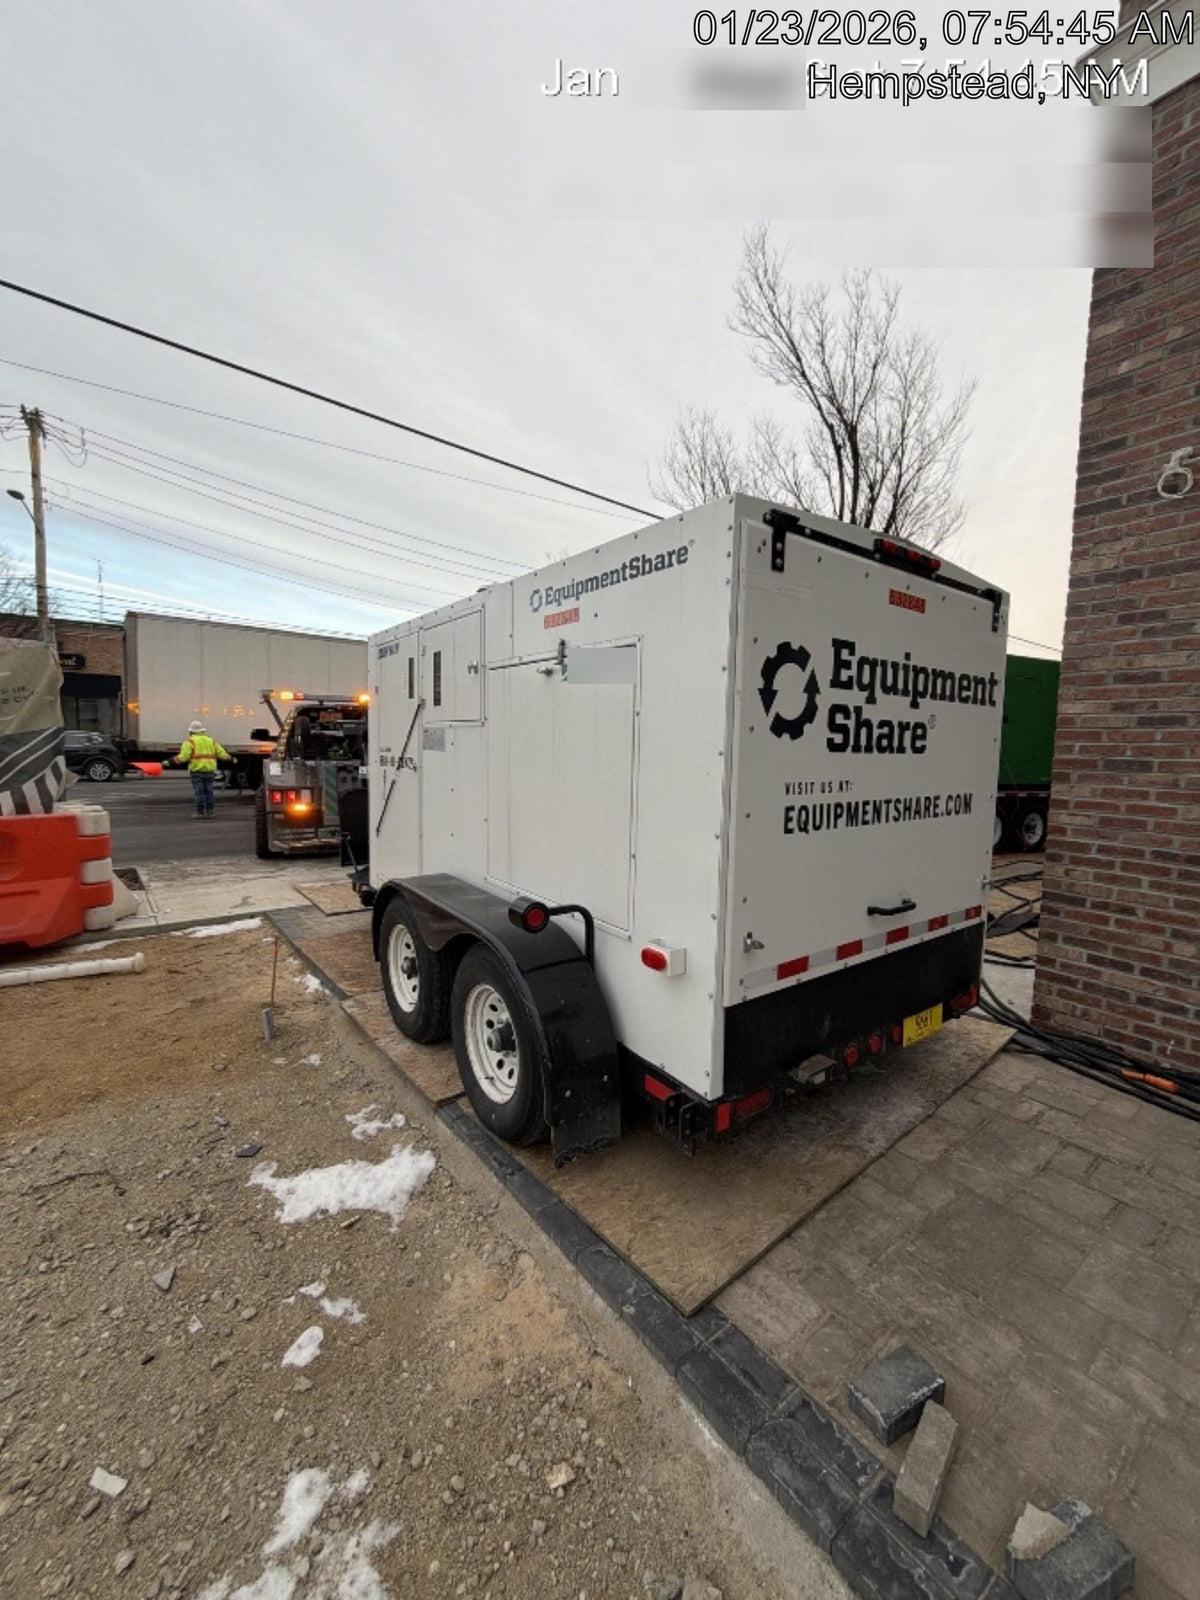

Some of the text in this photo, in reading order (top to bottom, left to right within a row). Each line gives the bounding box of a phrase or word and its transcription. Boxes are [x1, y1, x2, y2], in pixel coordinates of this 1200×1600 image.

[544, 544, 689, 607] EquipmentShare
[831, 639, 998, 709] Equipment
[826, 705, 928, 755] Share
[784, 781, 855, 796] VISIT US AT:
[784, 793, 973, 835] EQUIPMENTSHARE.COM
